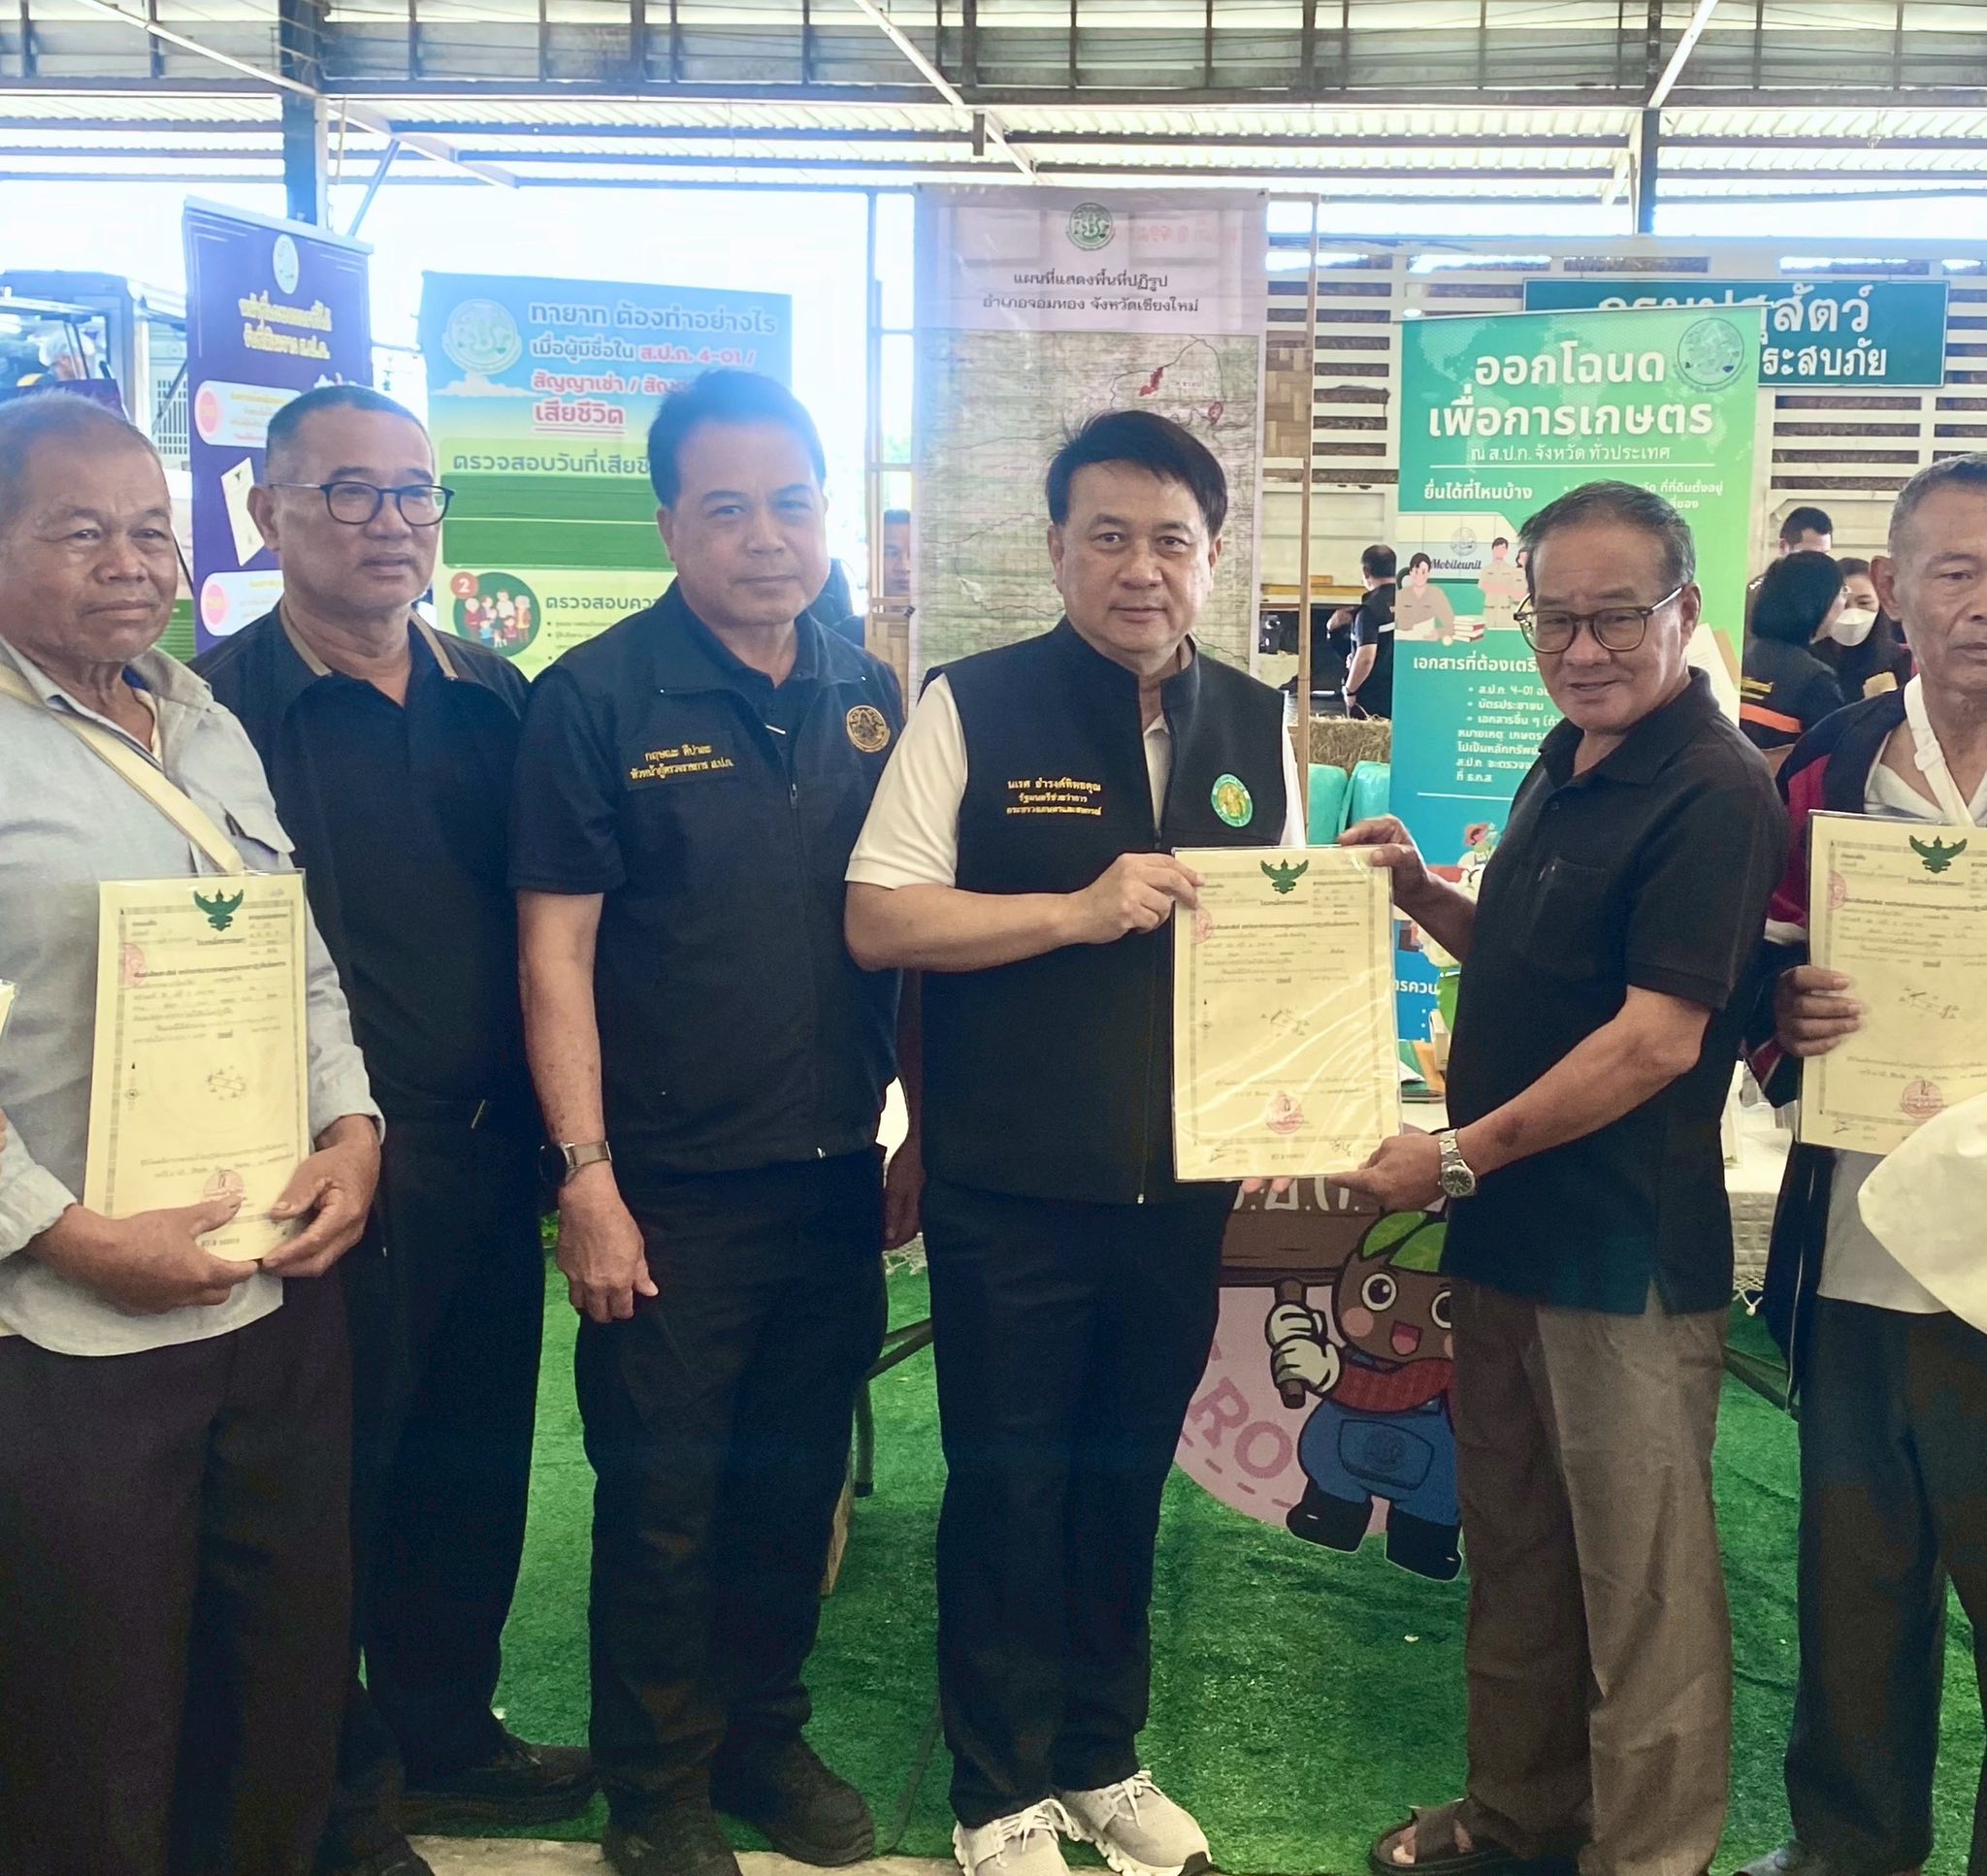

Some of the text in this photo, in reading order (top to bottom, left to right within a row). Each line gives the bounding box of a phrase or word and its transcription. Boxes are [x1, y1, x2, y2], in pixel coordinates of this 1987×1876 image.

[983, 294, 1199, 312] อำเภอจอมทอง จังหวัดเชียงใหม่
[532, 303, 775, 333] ทายาท ต้องทำอย่างไร
[533, 332, 634, 363] เมื่อผู้มีชื่อใน
[640, 344, 693, 363] ส.ป.ก.
[700, 349, 740, 365] 4-01
[1761, 338, 1888, 376] ระสบภัย
[1474, 340, 1665, 385] ออกโฉนด
[533, 371, 624, 394] สัญญาเช่า
[535, 400, 625, 425] เสียชีวิต
[1428, 383, 1713, 437] เพื่อการเกษตร
[453, 448, 650, 474] ตรวจสอบวันที่เสียชี
[1489, 444, 1531, 461] ส.ป.ก.
[1535, 443, 1585, 461] จังหวัด
[1589, 437, 1671, 460] ทั่วประเทศ
[1423, 479, 1533, 501] ยื่นได้ที่ไหนบ้าง
[459, 578, 471, 593] 2
[545, 596, 658, 610] ตรวจสอบคว
[1414, 650, 1540, 672] เอกสารที่ต้องเตรี
[1189, 1339, 1293, 1479] RO
